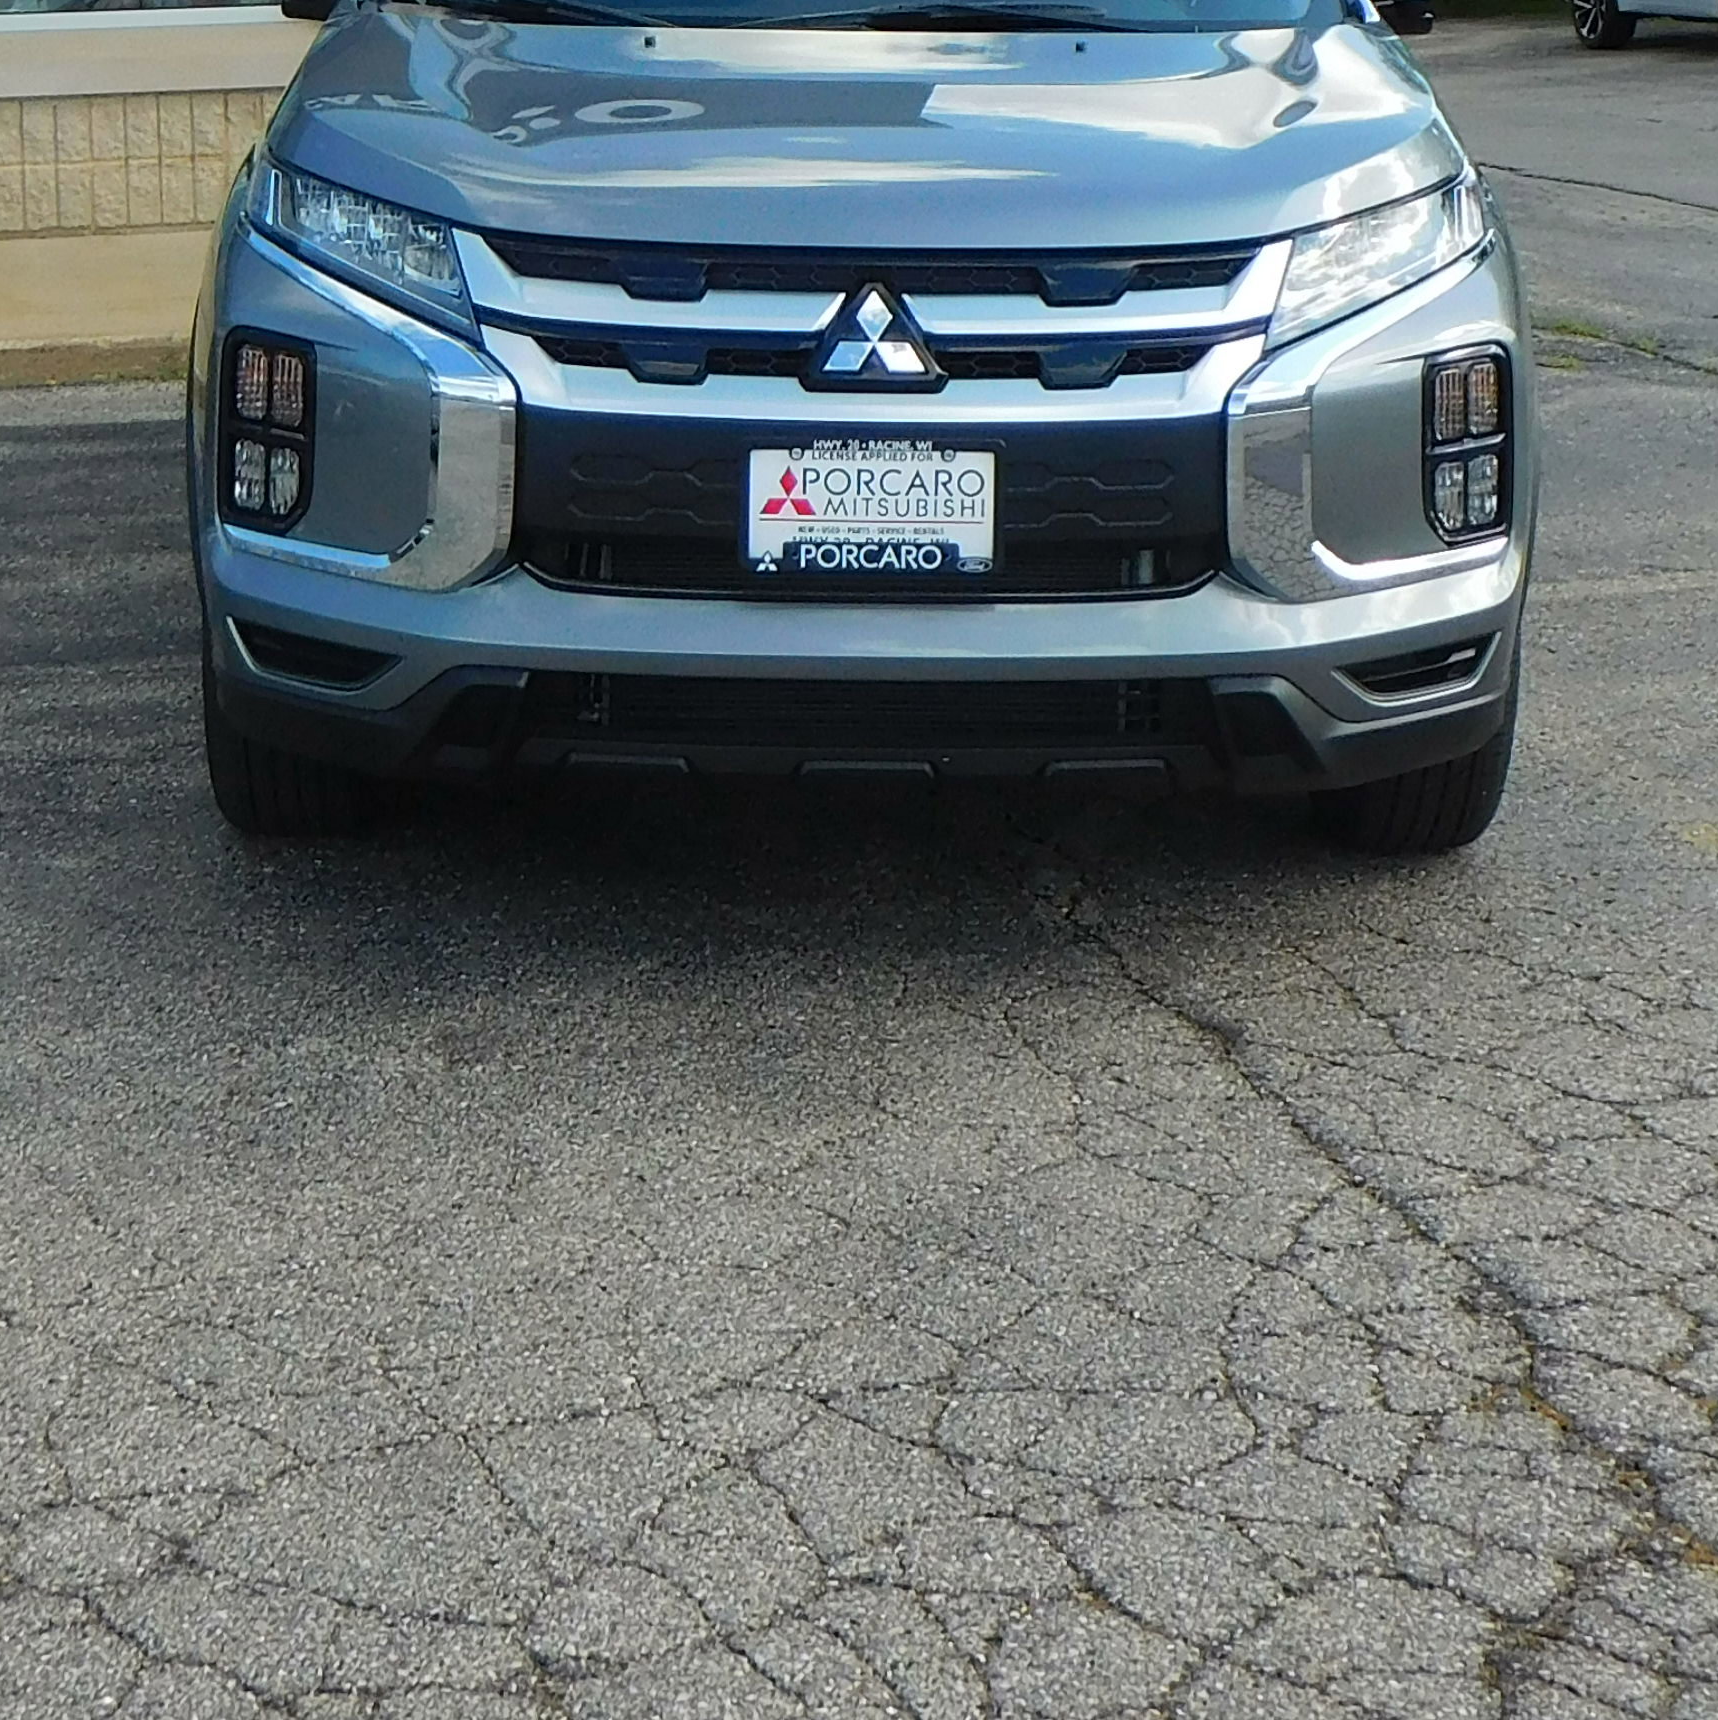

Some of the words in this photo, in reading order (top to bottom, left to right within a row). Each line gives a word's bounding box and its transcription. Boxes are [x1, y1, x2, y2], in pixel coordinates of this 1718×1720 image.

[812, 450, 857, 461] LICENSE
[861, 451, 908, 462] APPLIED
[911, 452, 934, 462] FOR
[916, 441, 933, 451] WI
[802, 467, 985, 497] PORCARO
[823, 497, 985, 517] MITSUBISHI
[800, 543, 943, 569] PORCARO
